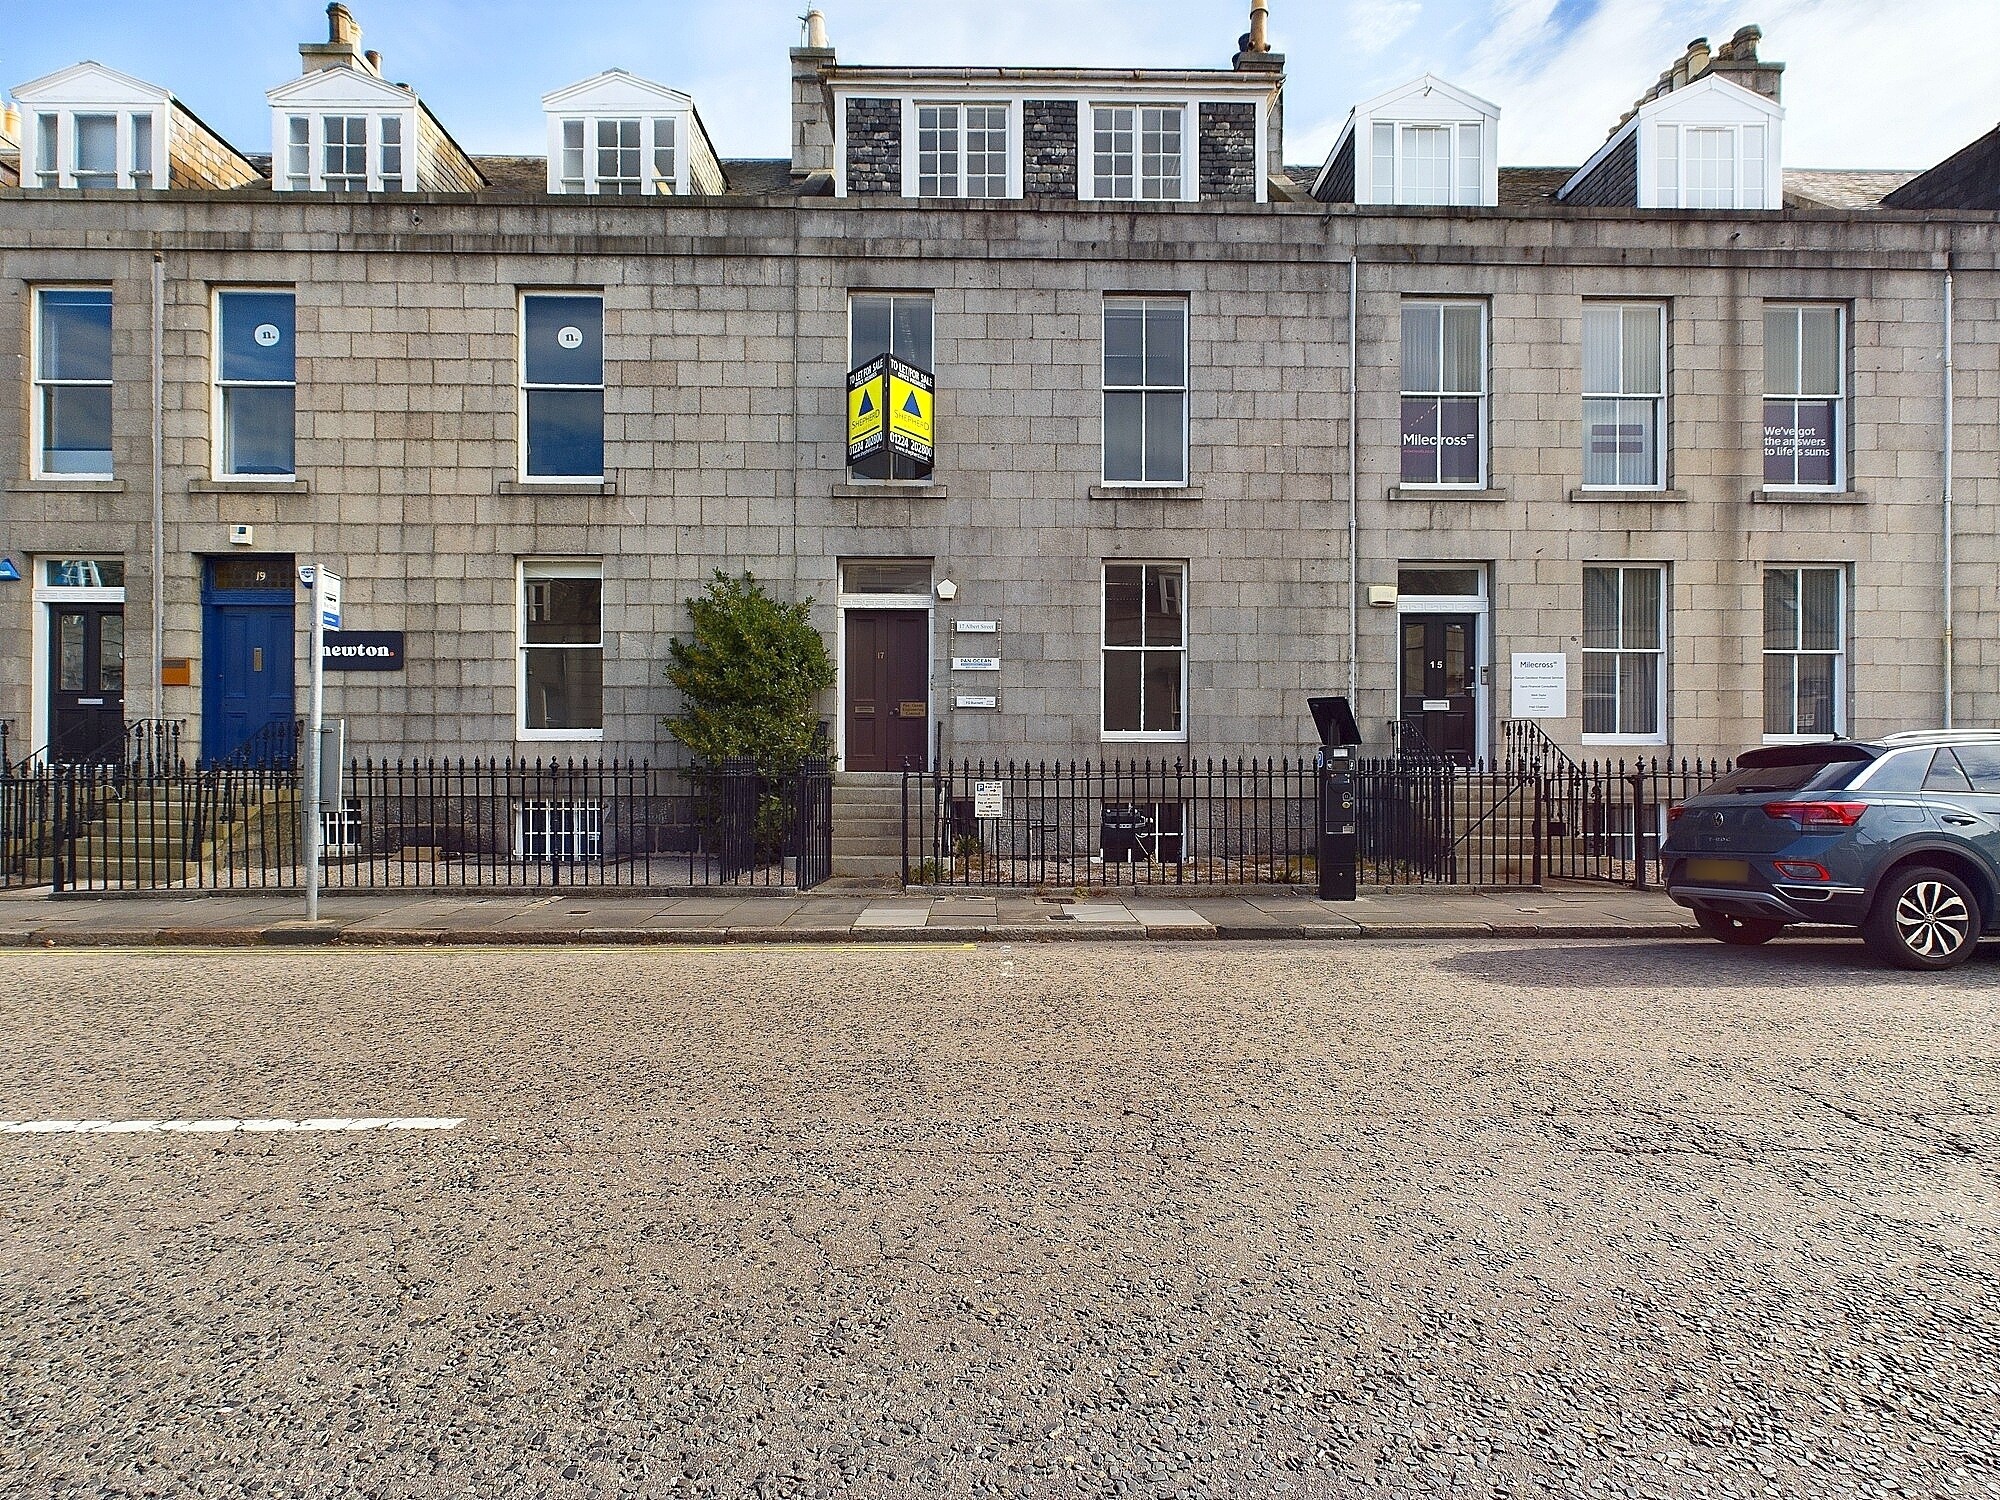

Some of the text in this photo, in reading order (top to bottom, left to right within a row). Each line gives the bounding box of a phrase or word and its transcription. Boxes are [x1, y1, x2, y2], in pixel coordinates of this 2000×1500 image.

[262, 331, 276, 339] n.
[565, 333, 579, 342] n.
[872, 358, 884, 372] SALE
[890, 358, 898, 371] TO
[920, 373, 933, 387] SALE
[852, 408, 880, 430] SHEPHERD
[894, 409, 930, 431] SHEPHERD
[1763, 426, 1816, 438] We've got
[889, 431, 933, 458] 01224 202800
[1763, 436, 1826, 446] the answers
[849, 440, 864, 456] 01224
[1763, 446, 1831, 456] to life's sums
[255, 571, 266, 582] 19
[877, 651, 885, 660] 17
[1430, 660, 1443, 669] 15
